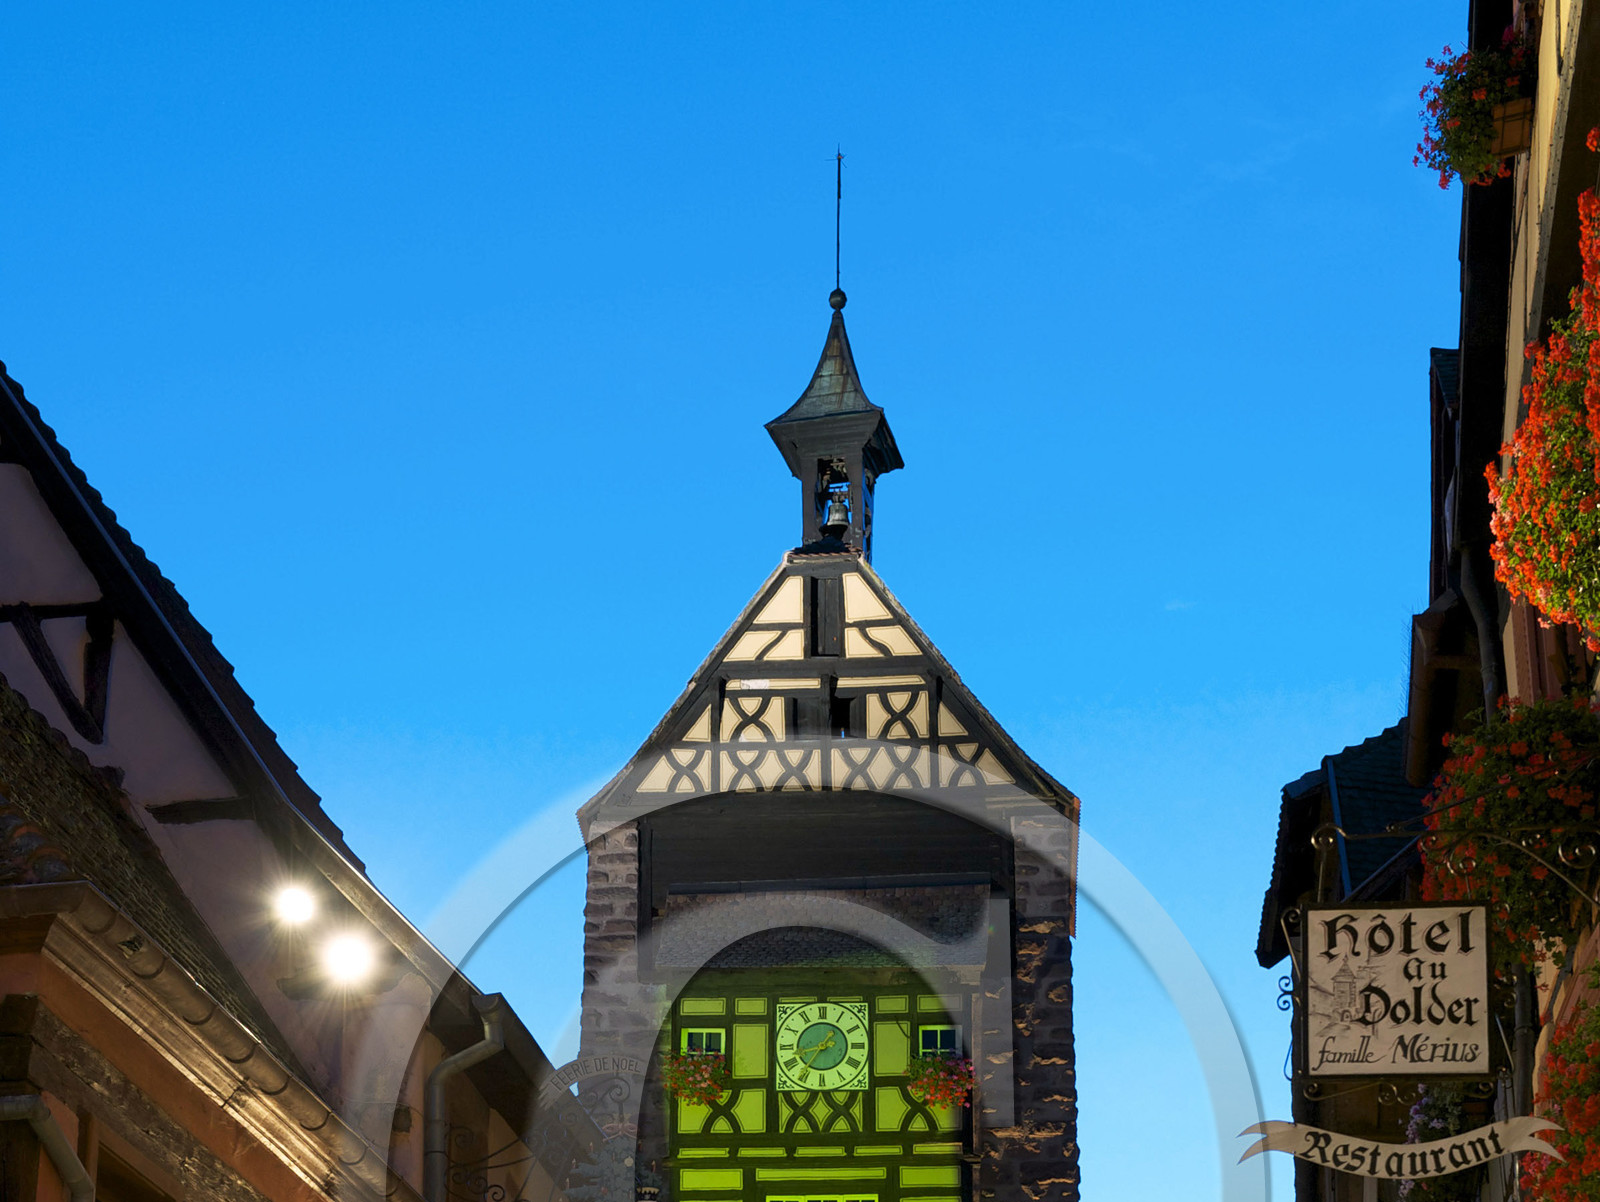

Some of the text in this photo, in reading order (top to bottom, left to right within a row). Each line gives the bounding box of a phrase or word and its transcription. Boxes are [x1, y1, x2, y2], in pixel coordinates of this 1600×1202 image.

[1319, 909, 1476, 960] Hôtel
[1403, 957, 1447, 982] au
[1353, 981, 1480, 1026] Dolder
[799, 1011, 811, 1024] XI
[818, 1006, 827, 1019] XII
[836, 1011, 845, 1023] I
[784, 1024, 799, 1036] X
[846, 1024, 861, 1034] II
[780, 1043, 794, 1051] IX
[1312, 1033, 1481, 1071] famille Mérius
[594, 1057, 609, 1072] DE
[612, 1058, 641, 1073] NOEL
[819, 1073, 826, 1086] VI
[836, 1069, 846, 1082] V
[1300, 1126, 1505, 1177] Restaurant
